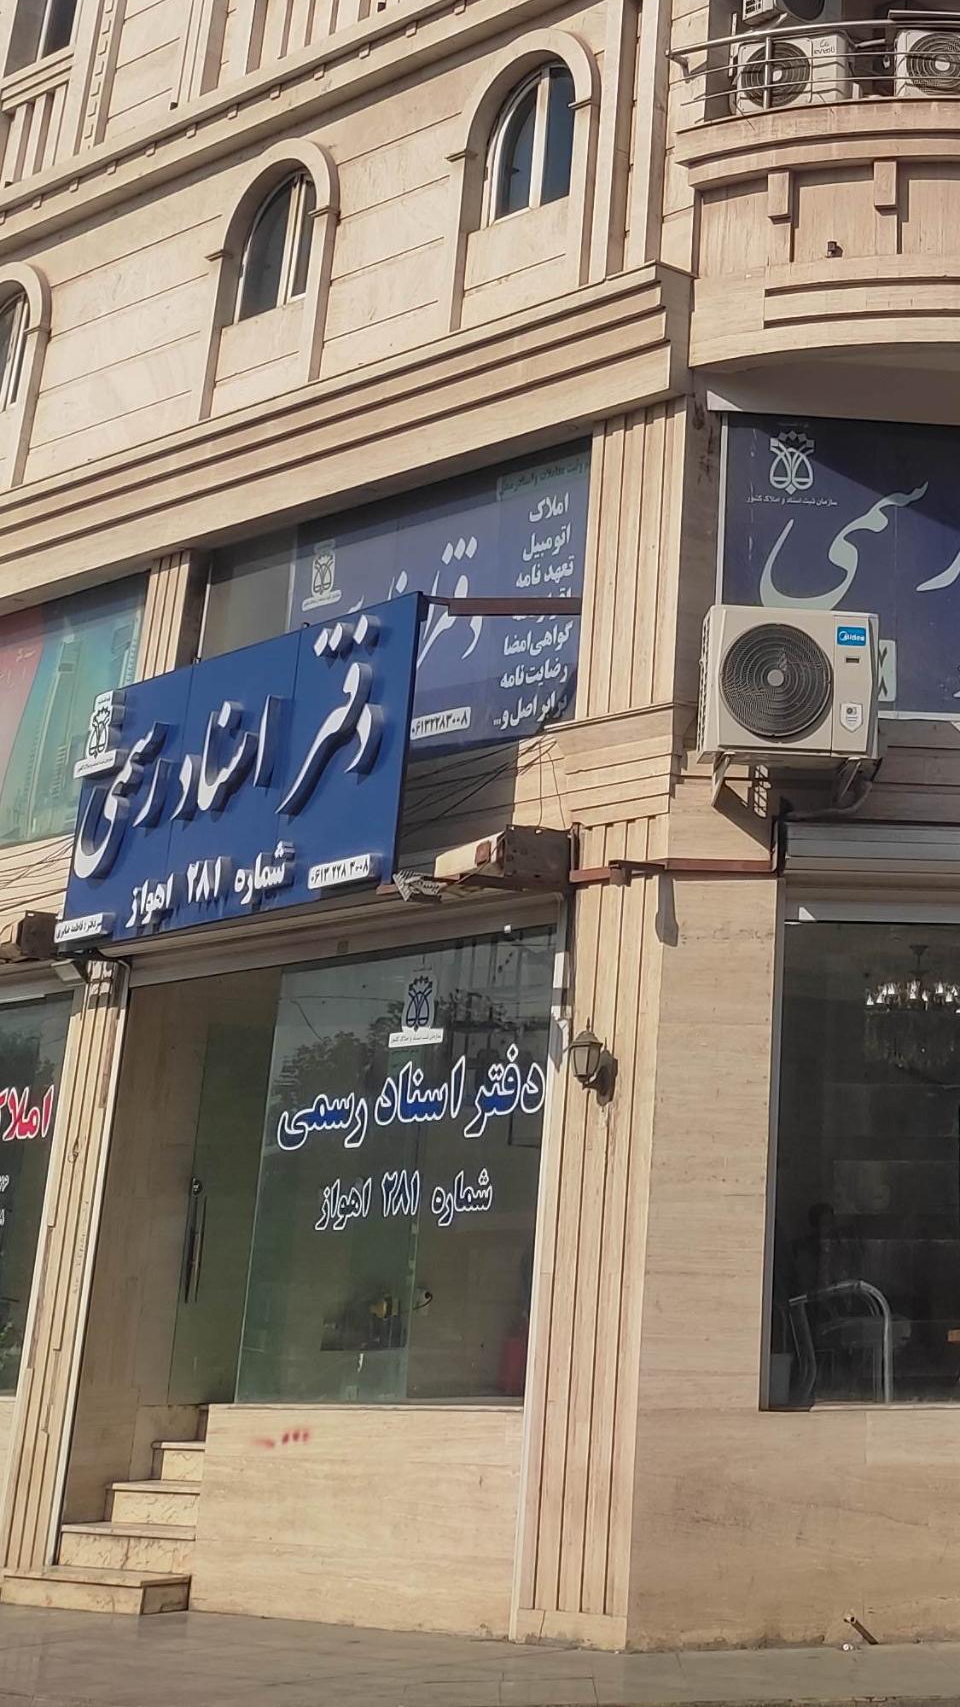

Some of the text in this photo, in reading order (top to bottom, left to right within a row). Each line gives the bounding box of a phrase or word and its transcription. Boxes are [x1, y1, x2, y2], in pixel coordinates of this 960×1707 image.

[529, 492, 569, 522] املاک
[515, 554, 575, 588] تعهد نامه
[522, 522, 571, 561] اتومبیل
[73, 614, 382, 880] دفتر اسناد رسمی
[125, 840, 291, 929] شماره ۲۸۱ اهواز
[0, 1084, 55, 1142] املا
[277, 1043, 546, 1151] دفتر اسناد رسمی
[315, 1167, 493, 1231] شماره ۲۸۱ اهواز
